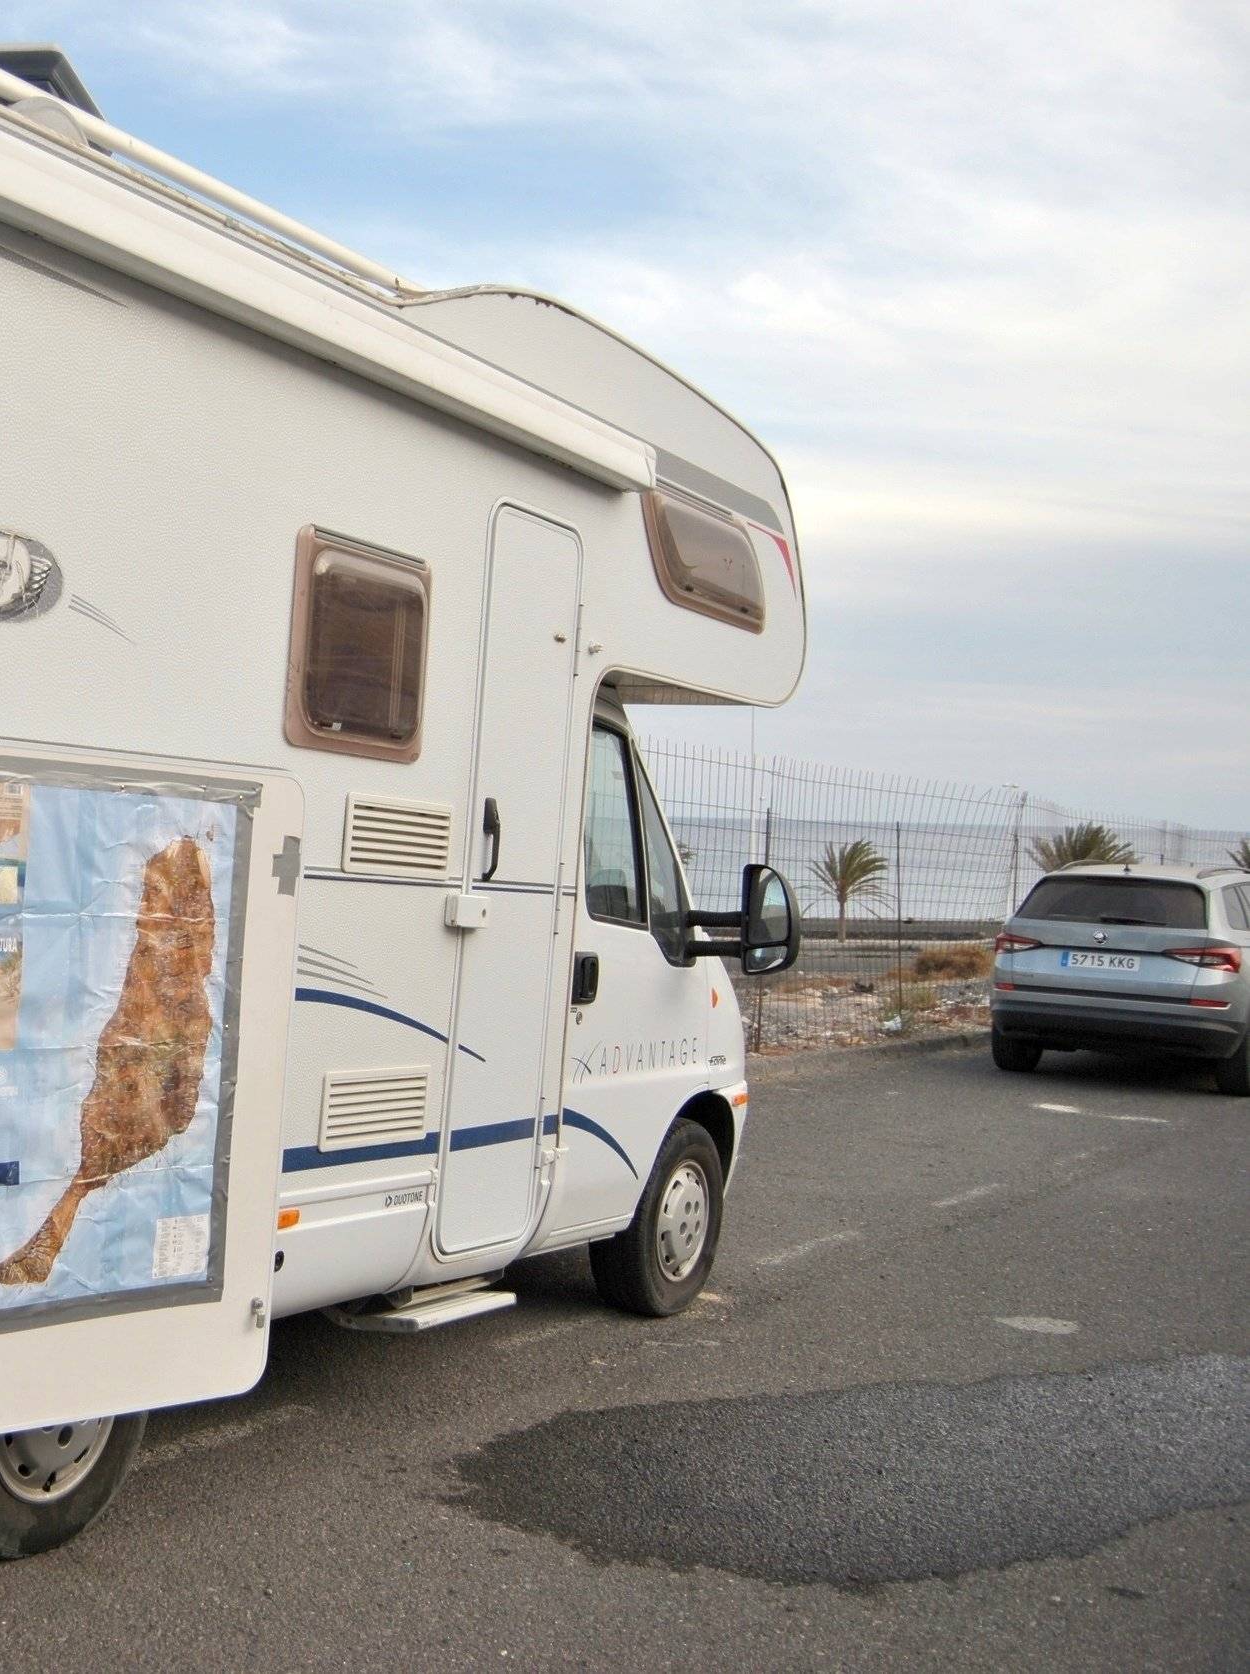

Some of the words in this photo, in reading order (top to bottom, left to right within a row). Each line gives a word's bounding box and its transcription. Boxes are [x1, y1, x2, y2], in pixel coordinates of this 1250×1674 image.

[1070, 953, 1105, 968] 5715
[1108, 955, 1136, 970] KKG
[600, 1037, 698, 1075] ADVANTAGE
